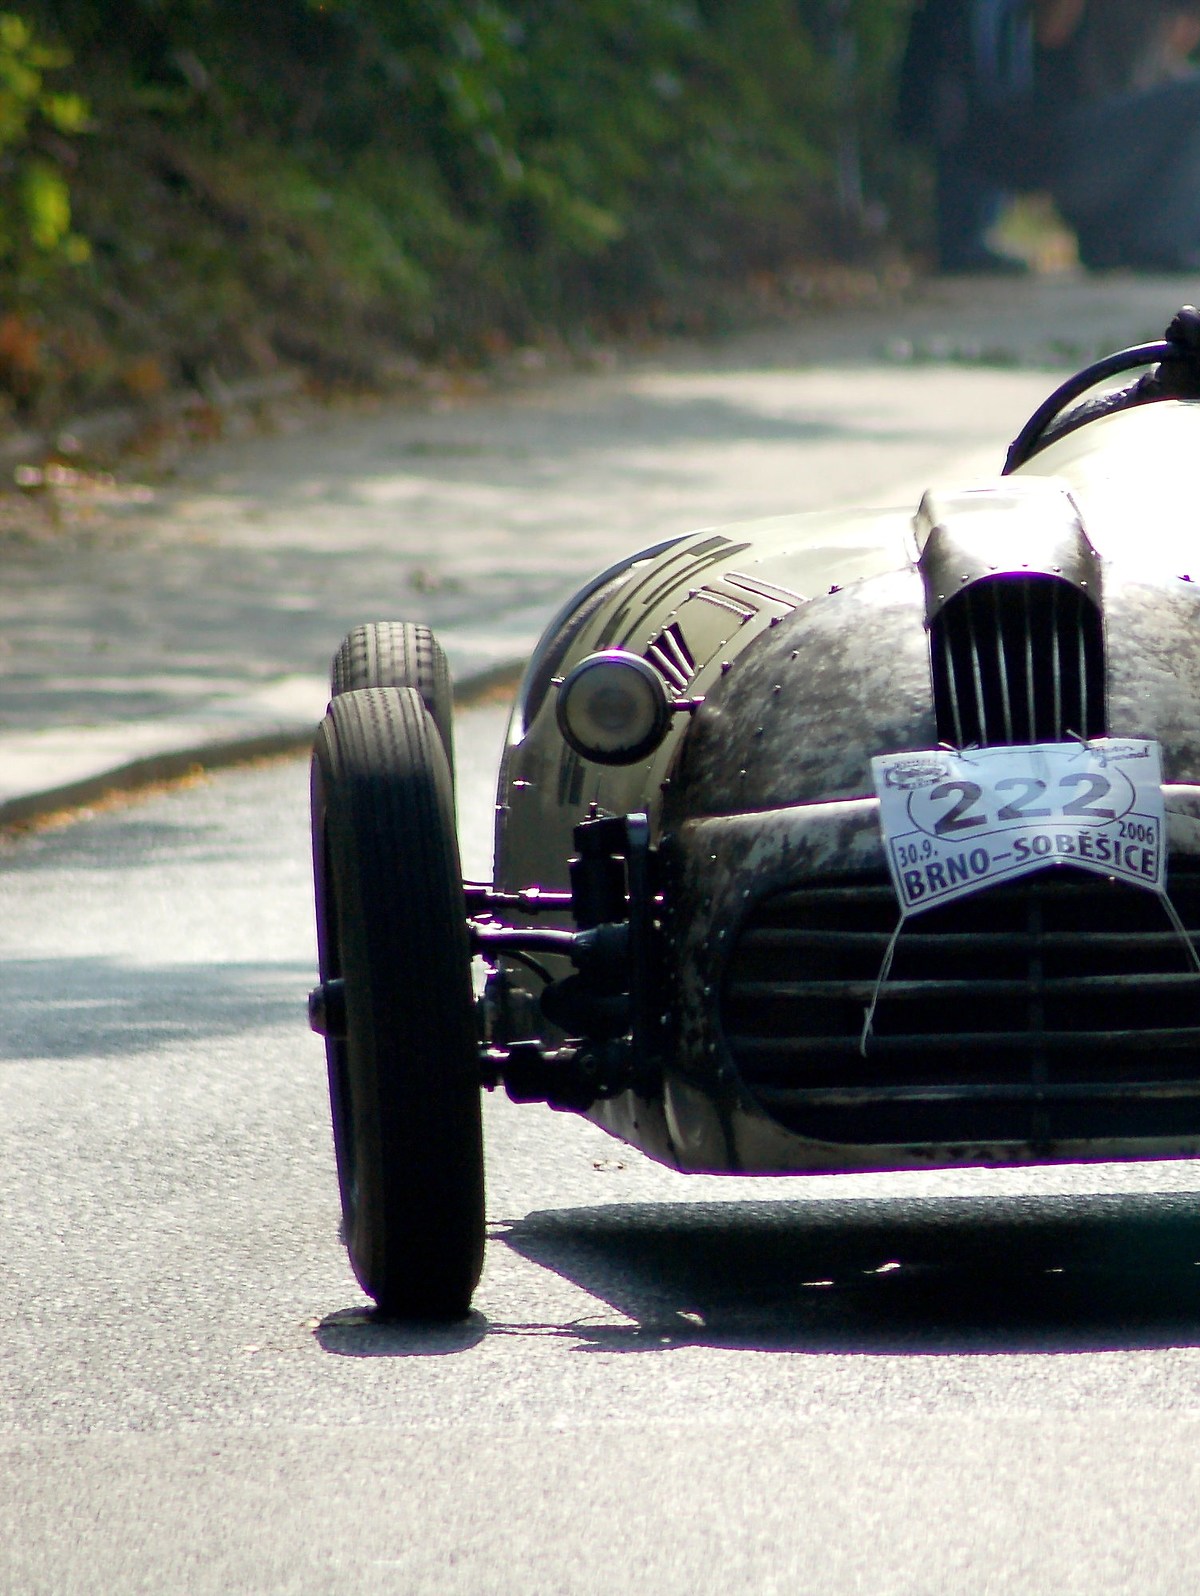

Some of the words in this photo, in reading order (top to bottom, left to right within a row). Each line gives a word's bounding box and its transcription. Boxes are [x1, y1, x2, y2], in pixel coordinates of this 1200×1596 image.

[929, 773, 1116, 835] 222
[1118, 820, 1155, 845] 2006
[898, 839, 938, 868] 30.9.
